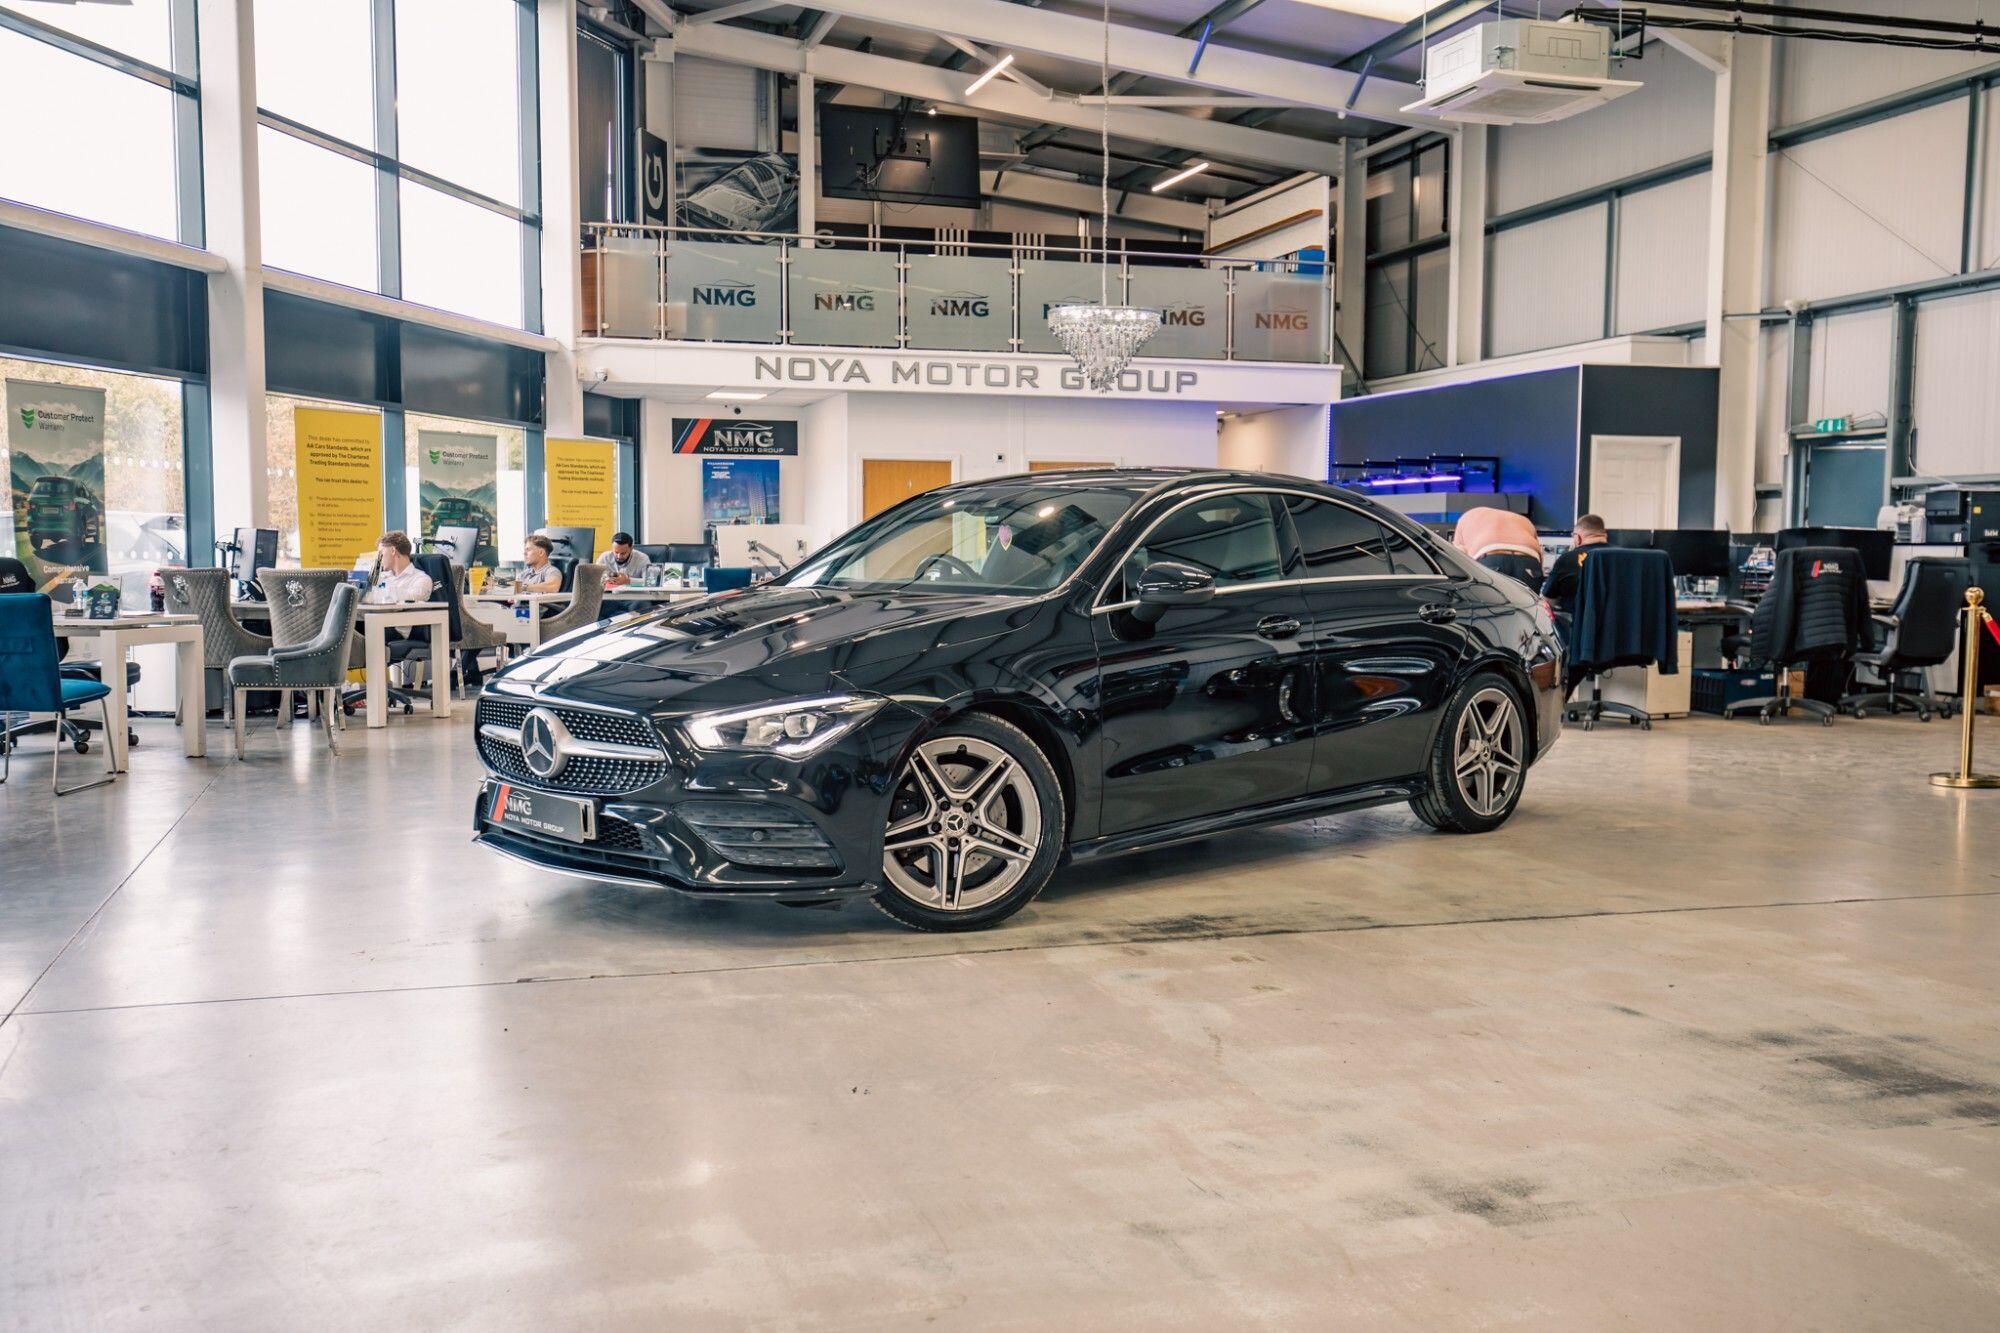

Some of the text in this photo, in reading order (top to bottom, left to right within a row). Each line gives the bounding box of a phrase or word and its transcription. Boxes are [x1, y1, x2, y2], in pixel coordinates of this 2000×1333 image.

[692, 287, 757, 308] NMG
[813, 292, 875, 312] NMG
[930, 300, 990, 318] NMG
[1255, 313, 1309, 331] NMG
[755, 356, 871, 384] NOYA
[891, 360, 1039, 388] MOTOR
[37, 410, 95, 423] Customer Protect
[714, 430, 775, 448] NMG
[469, 452, 489, 460] Protect
[503, 795, 532, 816] NMG
[521, 817, 543, 828] MOTOR
[543, 822, 565, 834] GROUP
